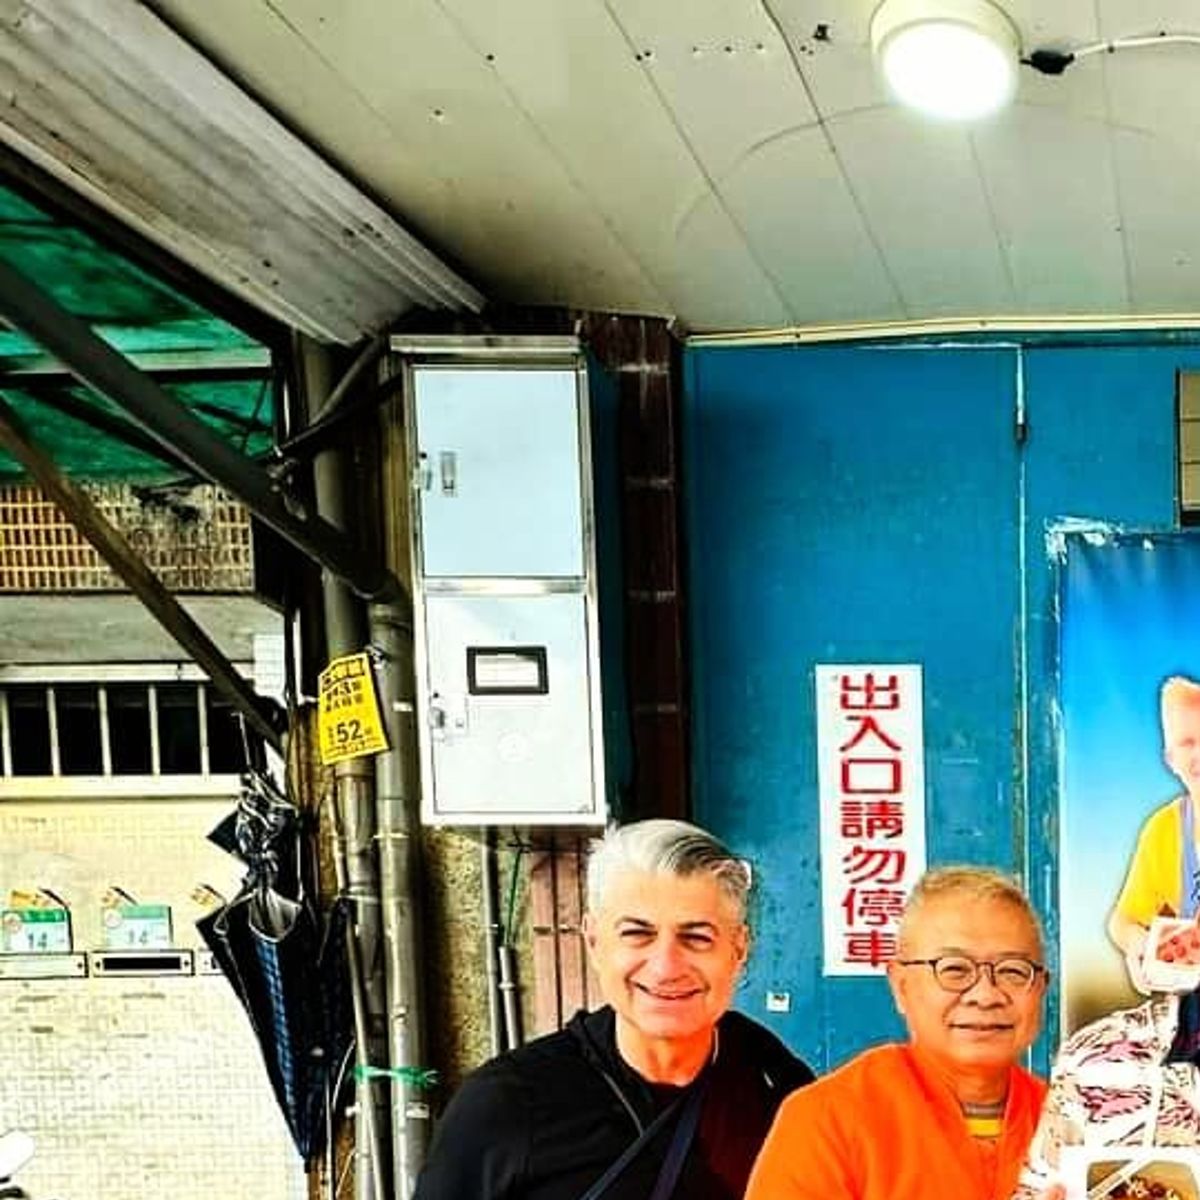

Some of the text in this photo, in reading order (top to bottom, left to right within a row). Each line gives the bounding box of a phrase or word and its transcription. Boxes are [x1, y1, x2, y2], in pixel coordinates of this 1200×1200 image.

[336, 720, 363, 743] 52
[839, 672, 906, 968] 出入口請勿停車
